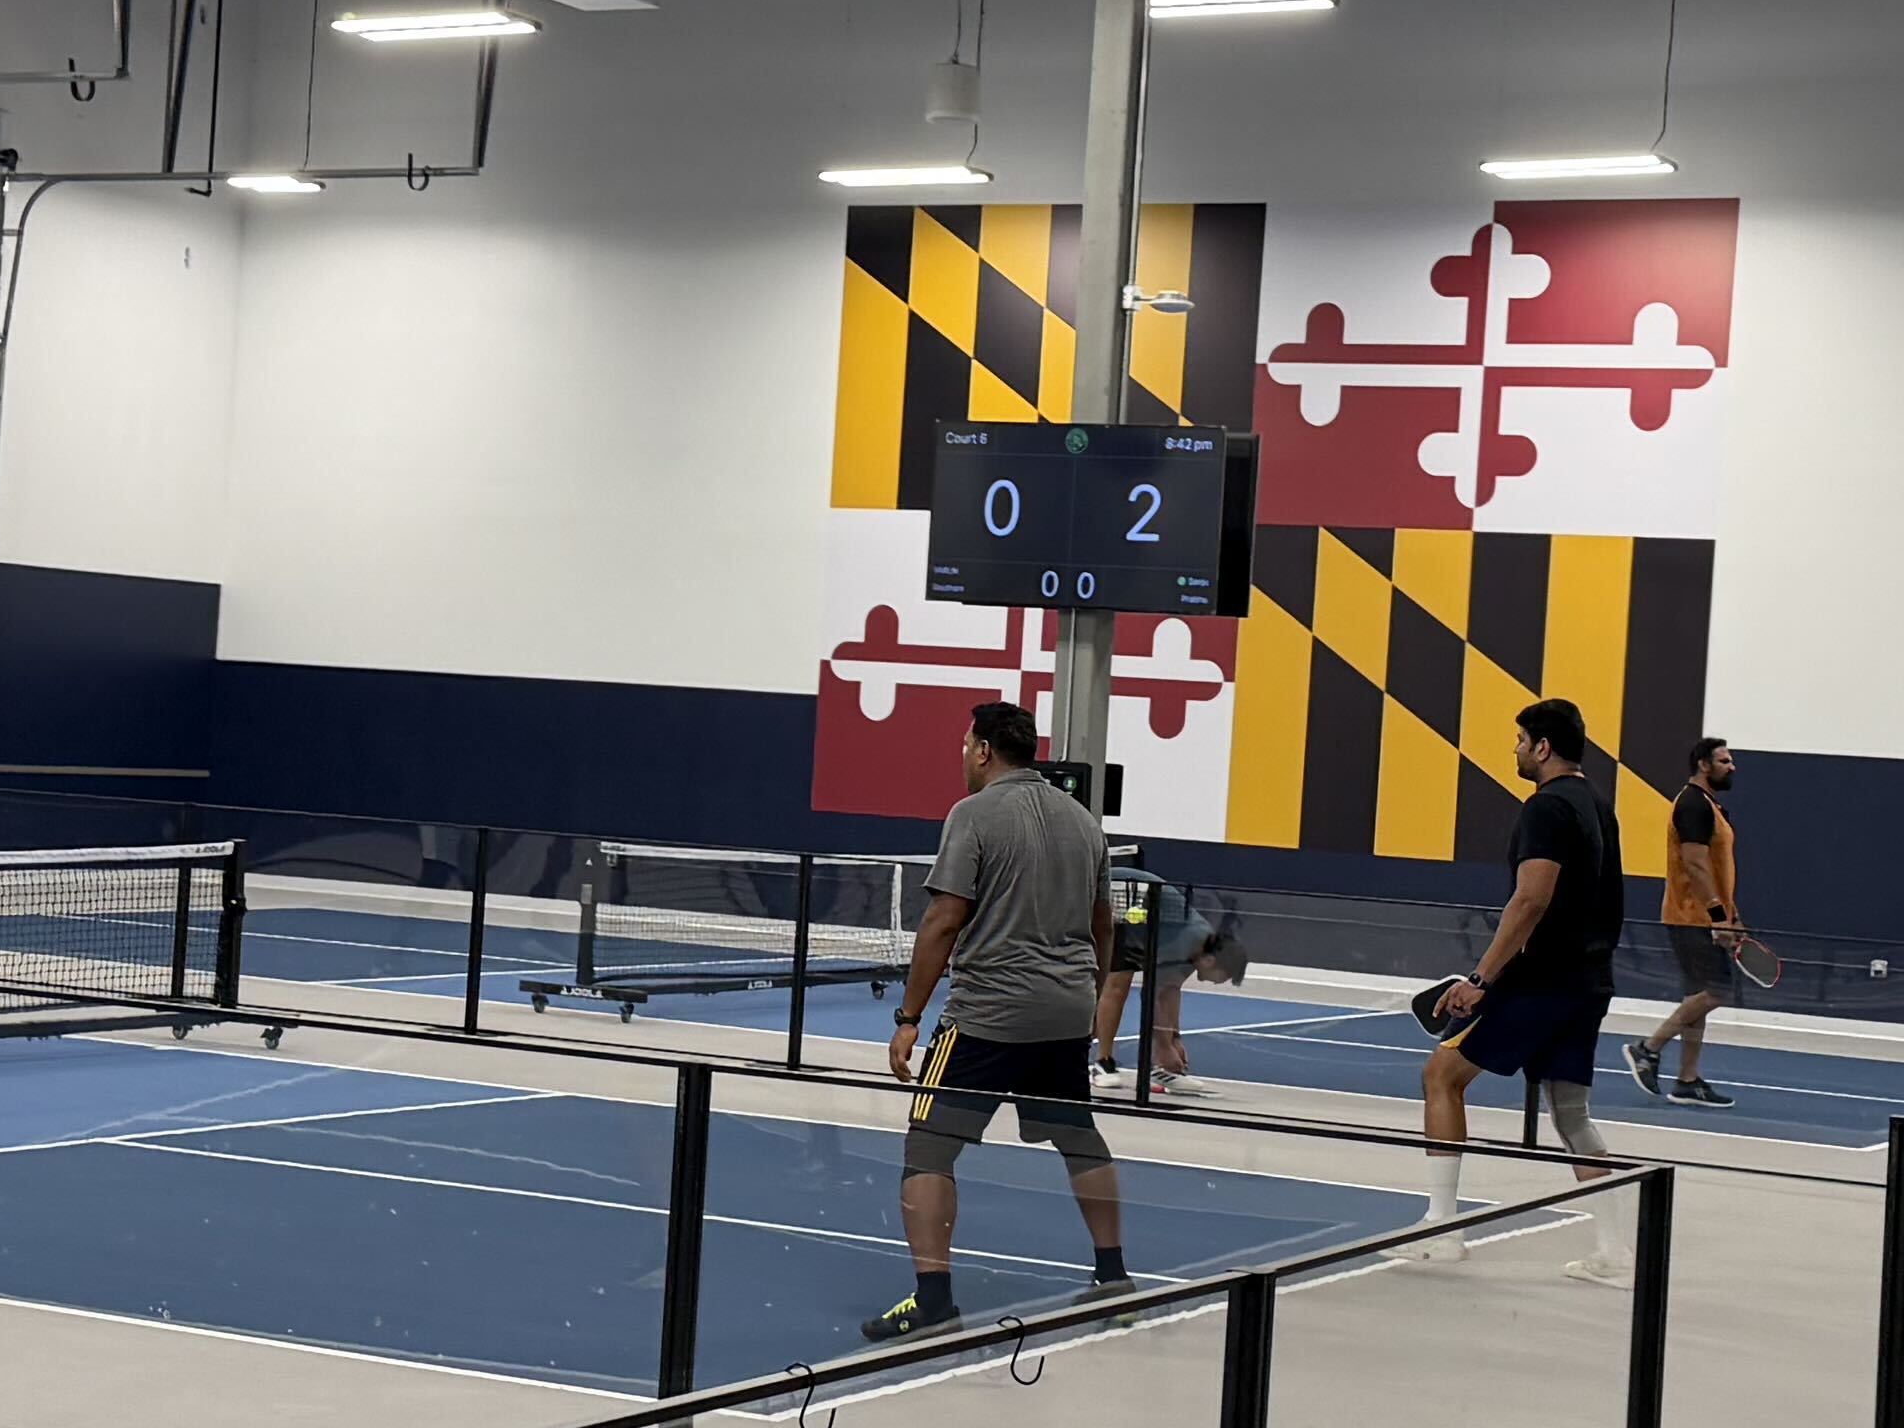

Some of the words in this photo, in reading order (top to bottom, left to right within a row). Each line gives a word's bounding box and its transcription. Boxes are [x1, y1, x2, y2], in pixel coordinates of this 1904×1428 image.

[984, 479, 1020, 537] 0
[1126, 483, 1162, 542] 2
[1041, 571, 1059, 597] 0
[1077, 572, 1095, 599] 0
